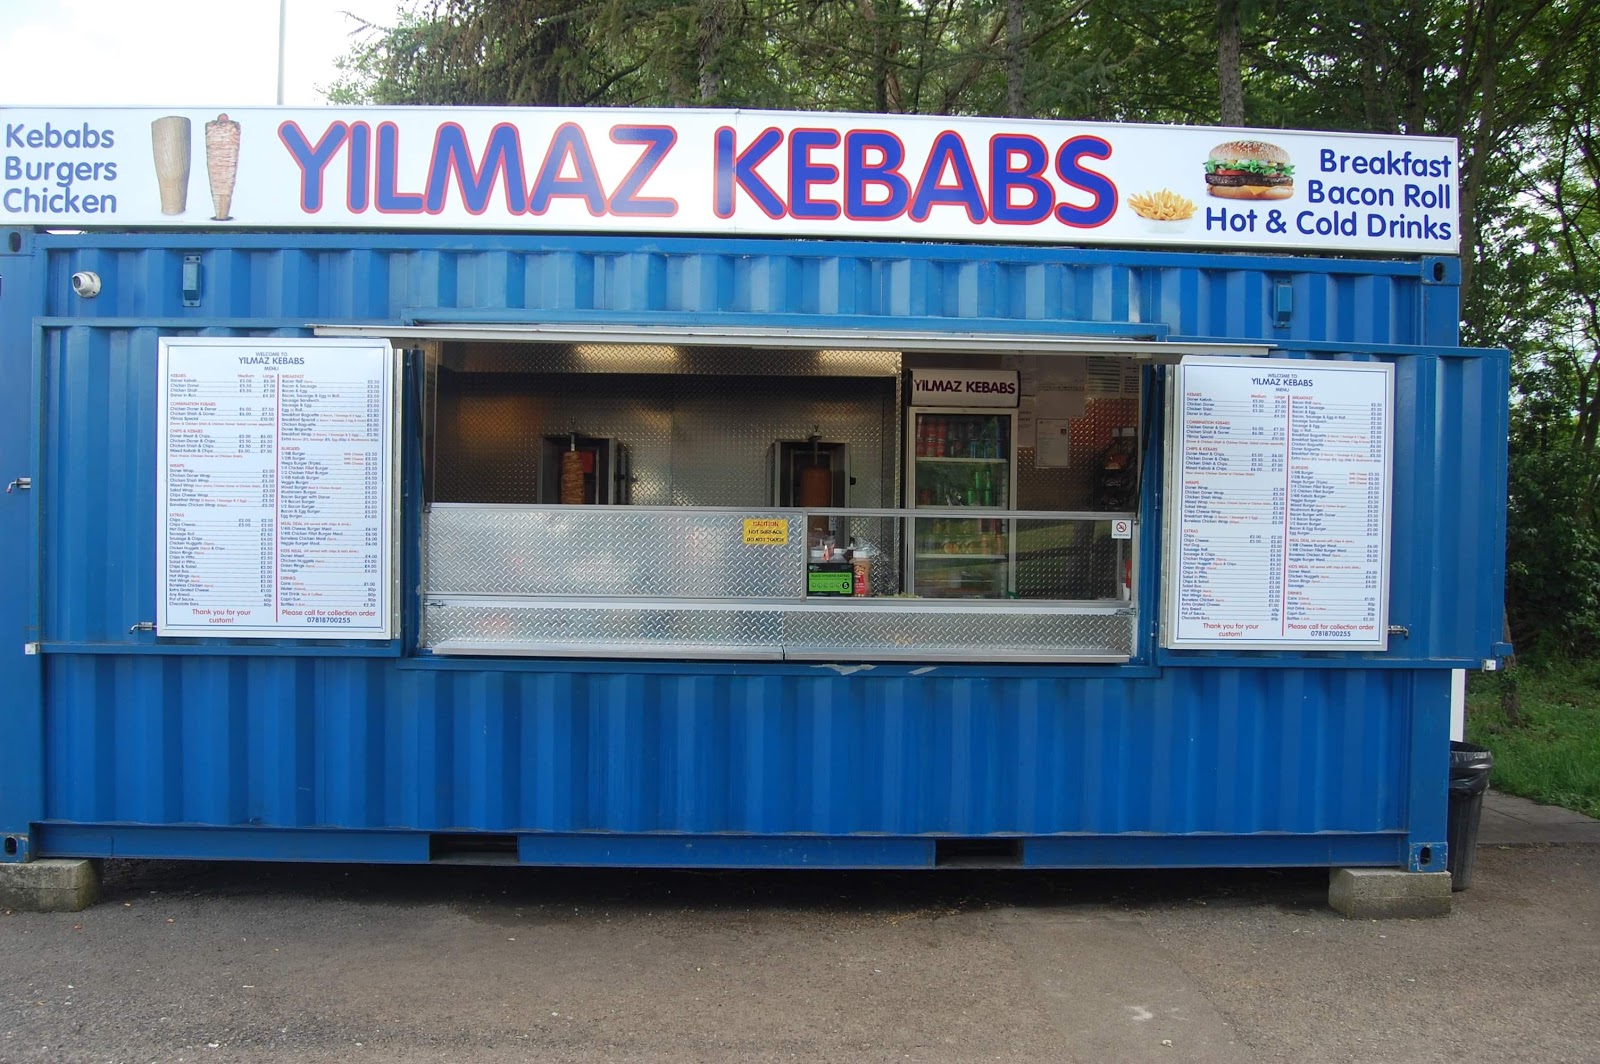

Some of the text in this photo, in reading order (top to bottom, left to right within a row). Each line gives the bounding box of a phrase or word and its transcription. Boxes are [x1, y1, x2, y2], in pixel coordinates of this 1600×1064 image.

[5, 123, 114, 150] Kebabs
[5, 156, 117, 187] Burgers
[277, 120, 1118, 229] YILMAZ KEBABS
[1320, 149, 1451, 177] Breakfast
[4, 187, 117, 214] Chicken
[1309, 180, 1451, 210] Bacon Roll
[1207, 208, 1451, 240] Hot & Cold Drinks
[914, 380, 1015, 394] YILMAZ KEBABS
